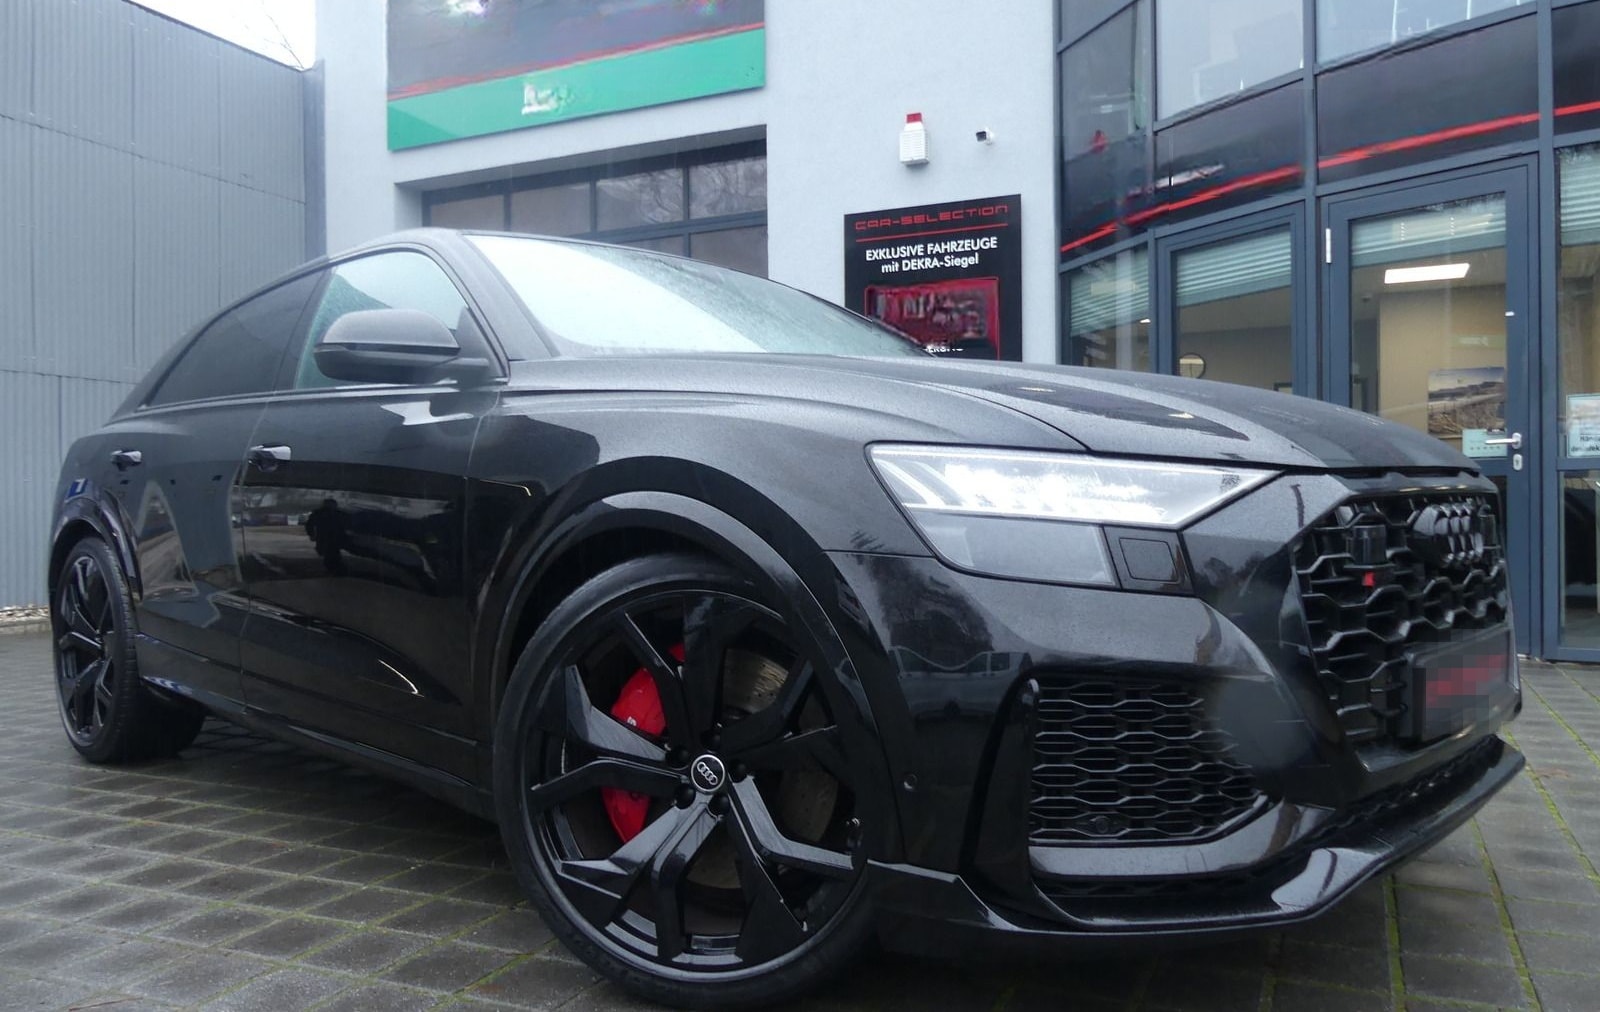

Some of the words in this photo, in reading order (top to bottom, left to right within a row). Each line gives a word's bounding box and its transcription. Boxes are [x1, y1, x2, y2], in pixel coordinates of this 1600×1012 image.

[855, 204, 1008, 230] CAR-SELECTION
[866, 244, 924, 261] EXKLUSIVE
[927, 236, 998, 255] FAHRZEUGE
[881, 261, 899, 273] mit
[902, 253, 979, 272] DEKRA-Siegel
